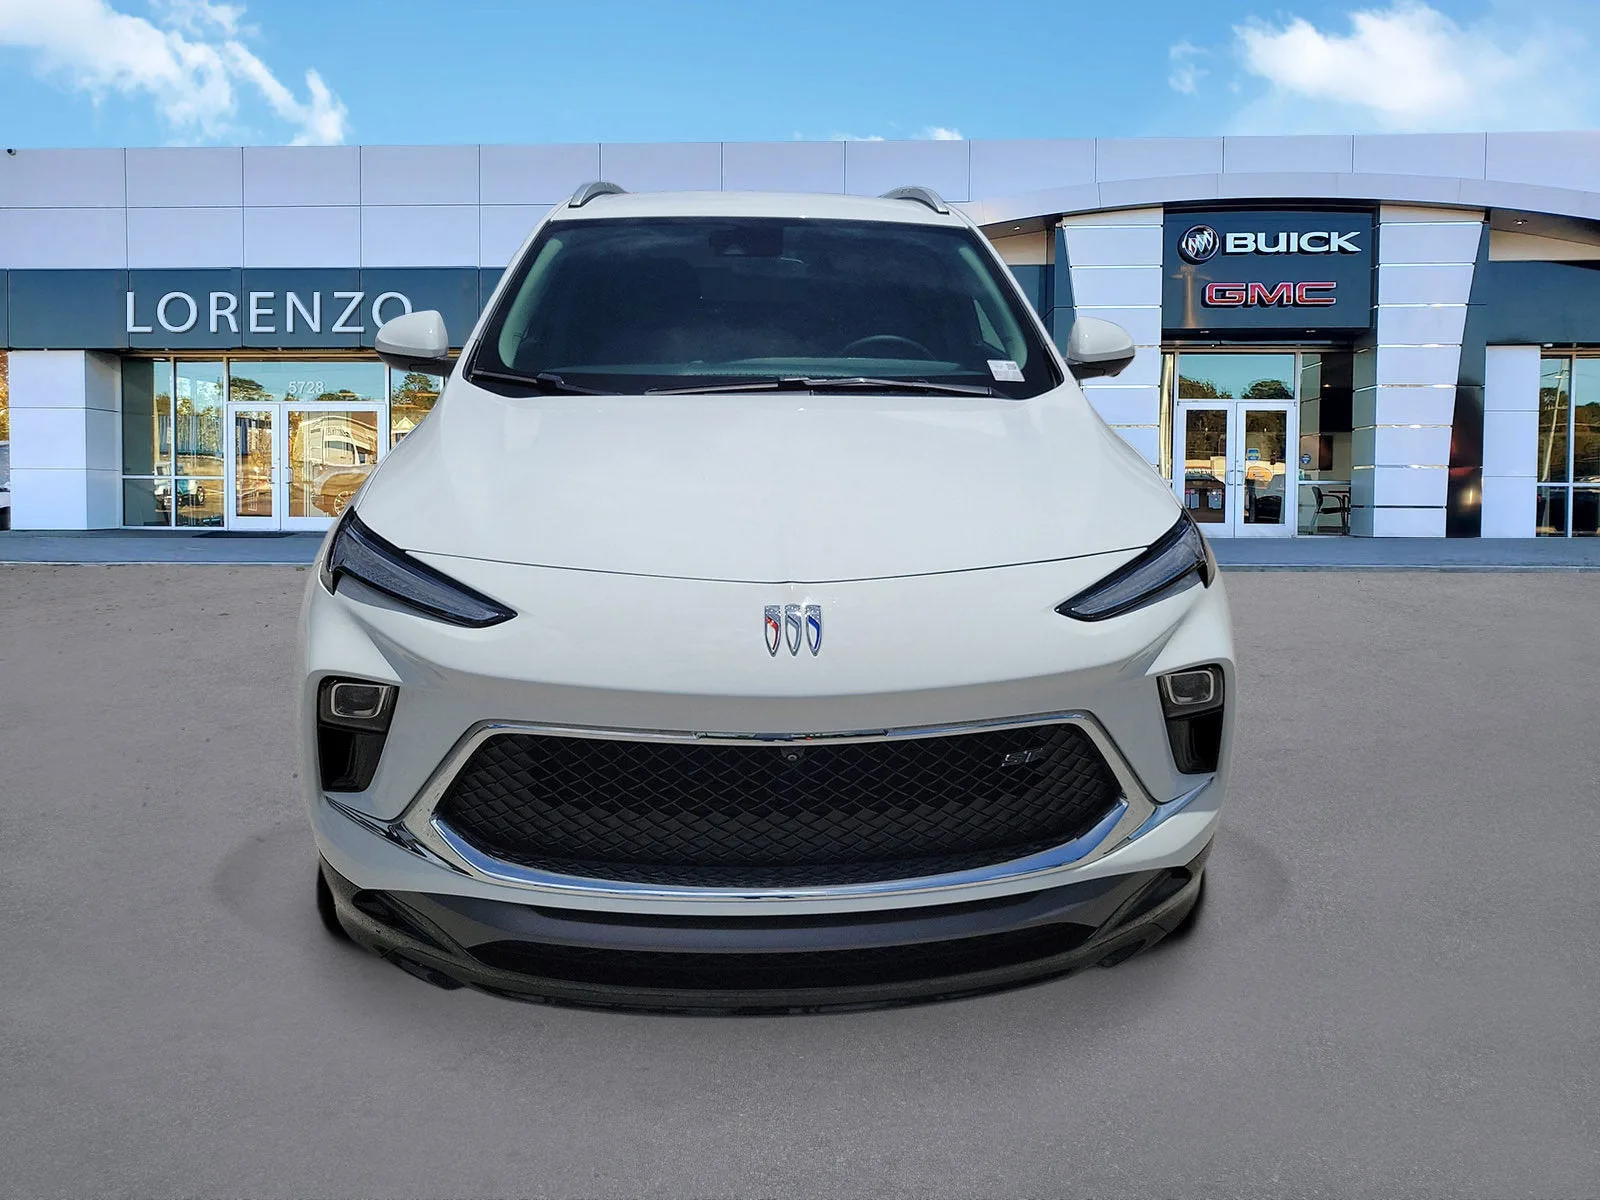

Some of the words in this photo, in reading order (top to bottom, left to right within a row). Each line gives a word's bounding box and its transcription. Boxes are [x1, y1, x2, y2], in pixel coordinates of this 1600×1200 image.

[1225, 231, 1362, 253] BUICK
[1204, 281, 1337, 305] GMC
[126, 291, 413, 333] LORENZO
[288, 380, 325, 394] 5728
